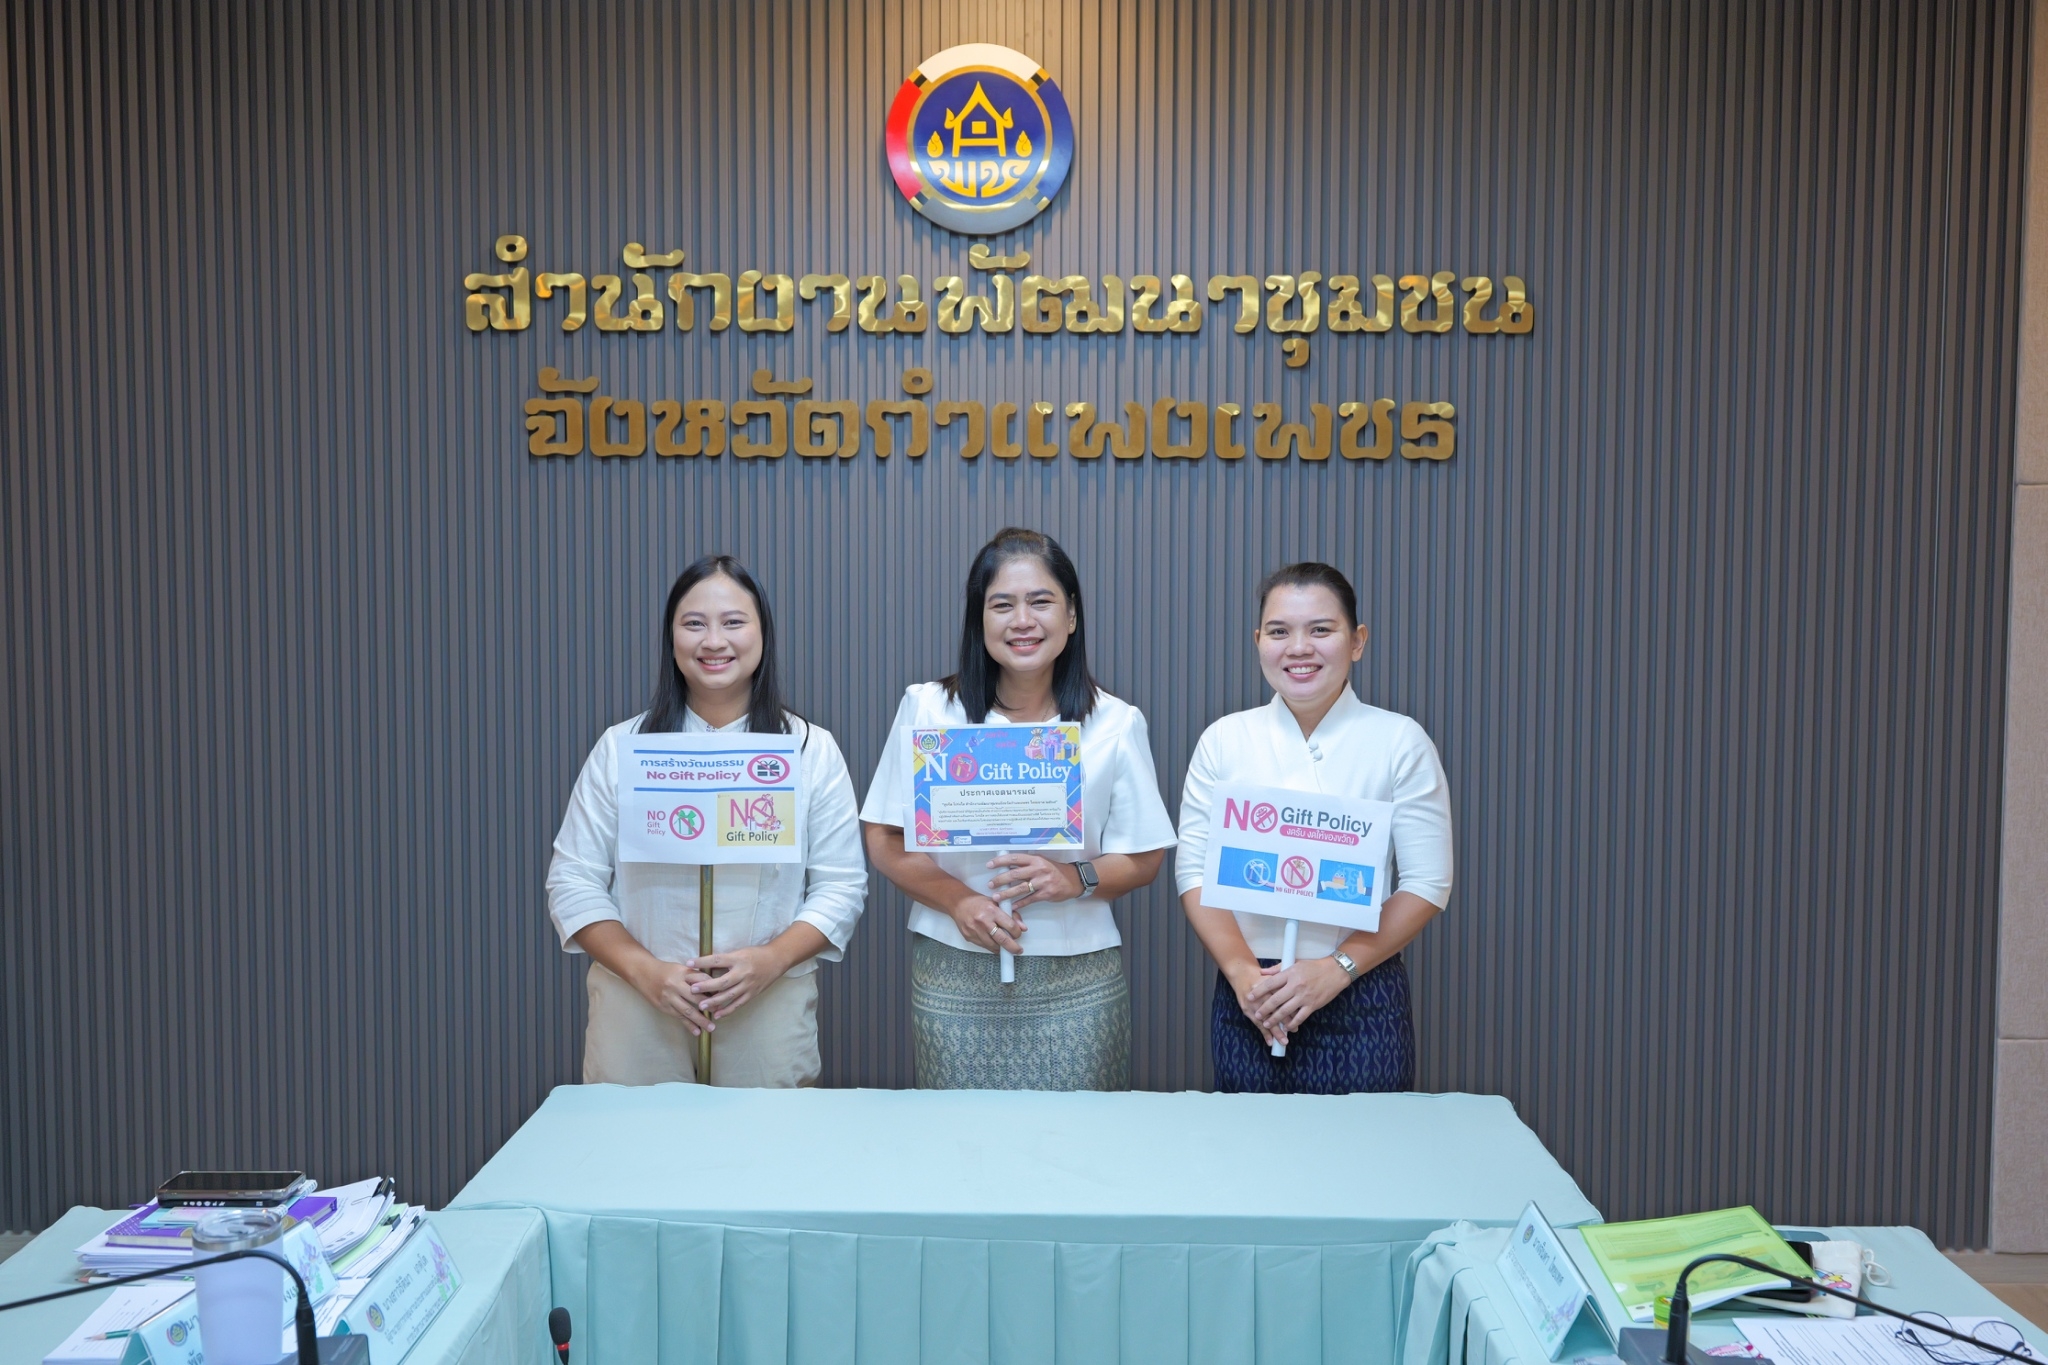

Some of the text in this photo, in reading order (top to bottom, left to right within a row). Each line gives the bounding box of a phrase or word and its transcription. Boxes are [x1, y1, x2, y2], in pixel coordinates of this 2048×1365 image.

[464, 235, 1534, 367] สำนักงานพัฒนาชุมชน
[525, 366, 1458, 461] จังหวัดกำแพงเพชร
[640, 758, 744, 768] การสร้างวัฒนธรรม
[646, 770, 741, 782] No Gift Policy
[979, 763, 1013, 780] Gift
[1017, 761, 1073, 783] Policy
[647, 811, 666, 821] NO
[647, 821, 660, 829] Gift
[1280, 807, 1313, 826] Gift
[1317, 811, 1373, 838] Policy
[647, 828, 666, 836] Policy
[726, 831, 778, 844] Gift Policy
